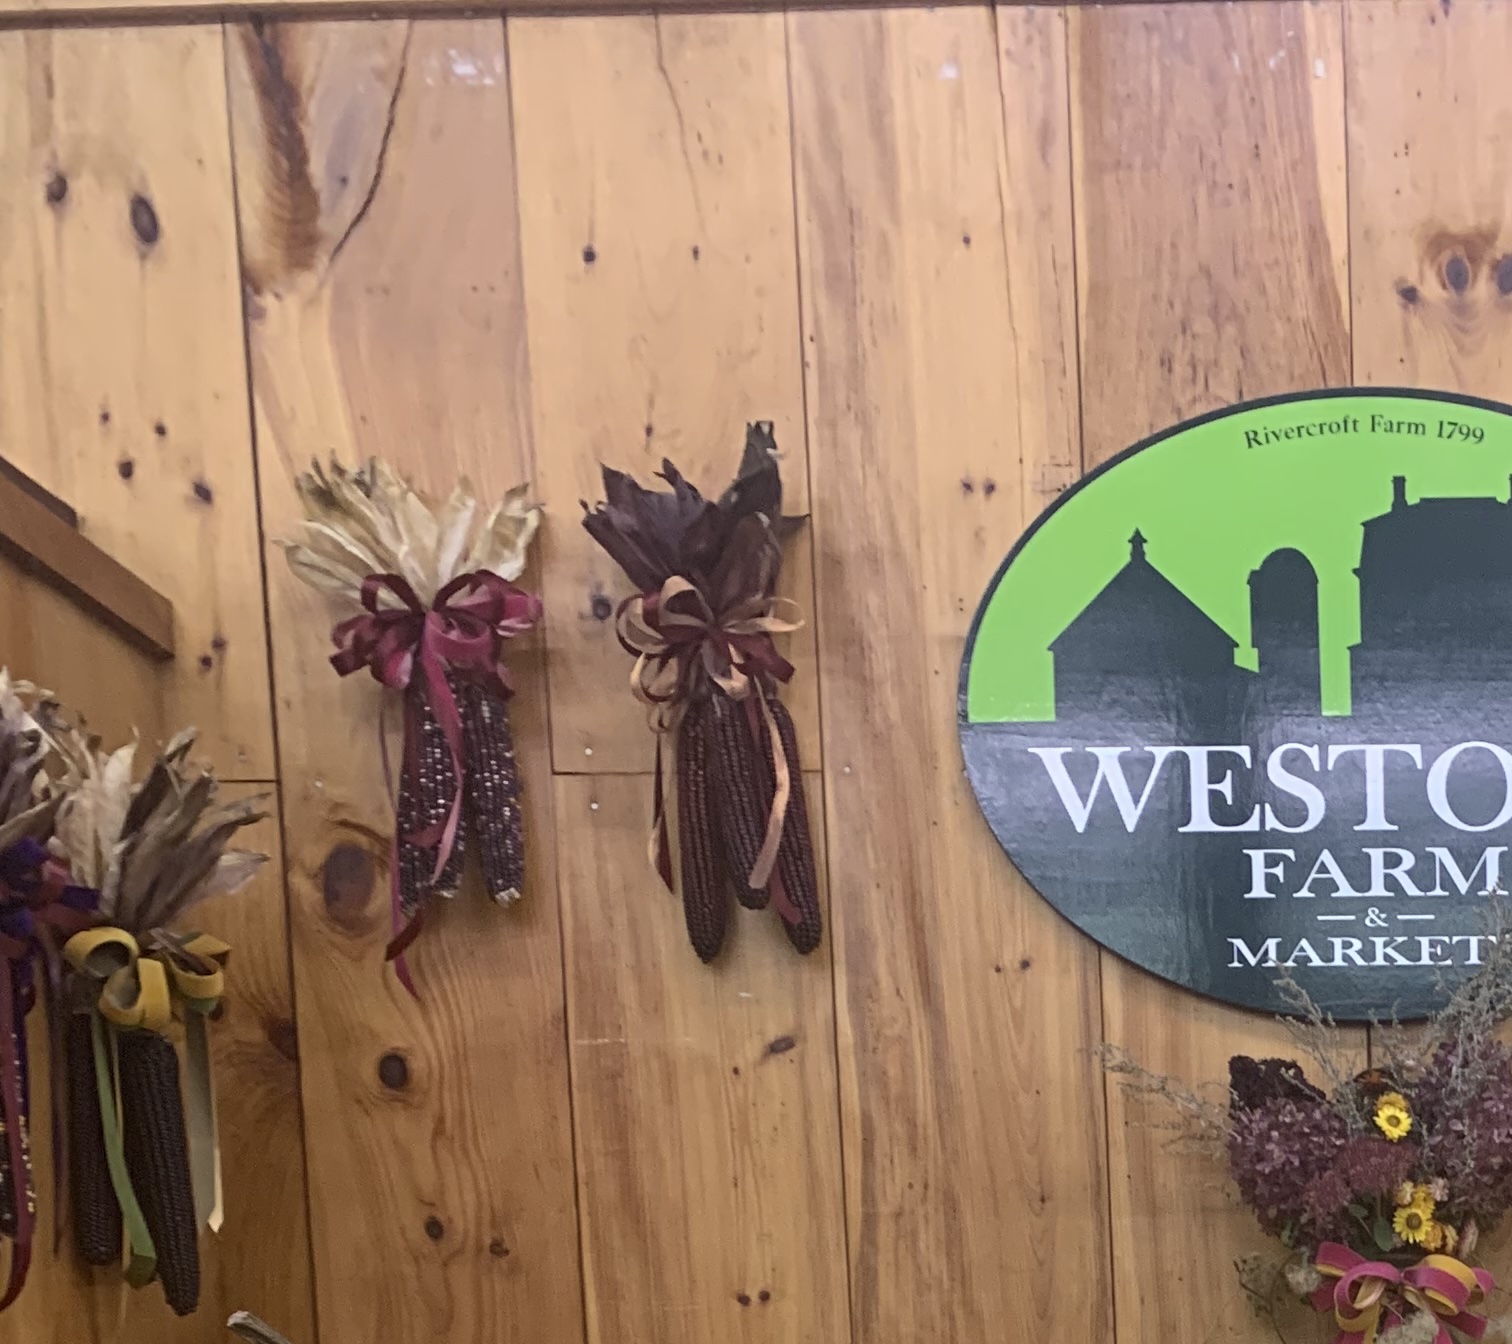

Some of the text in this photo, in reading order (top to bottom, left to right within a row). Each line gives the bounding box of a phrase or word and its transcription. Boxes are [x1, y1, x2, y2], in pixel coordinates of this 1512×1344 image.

[1243, 414, 1485, 449] Rivercroft Farm 1799
[1242, 846, 1509, 899] FARM
[1364, 906, 1389, 928] &
